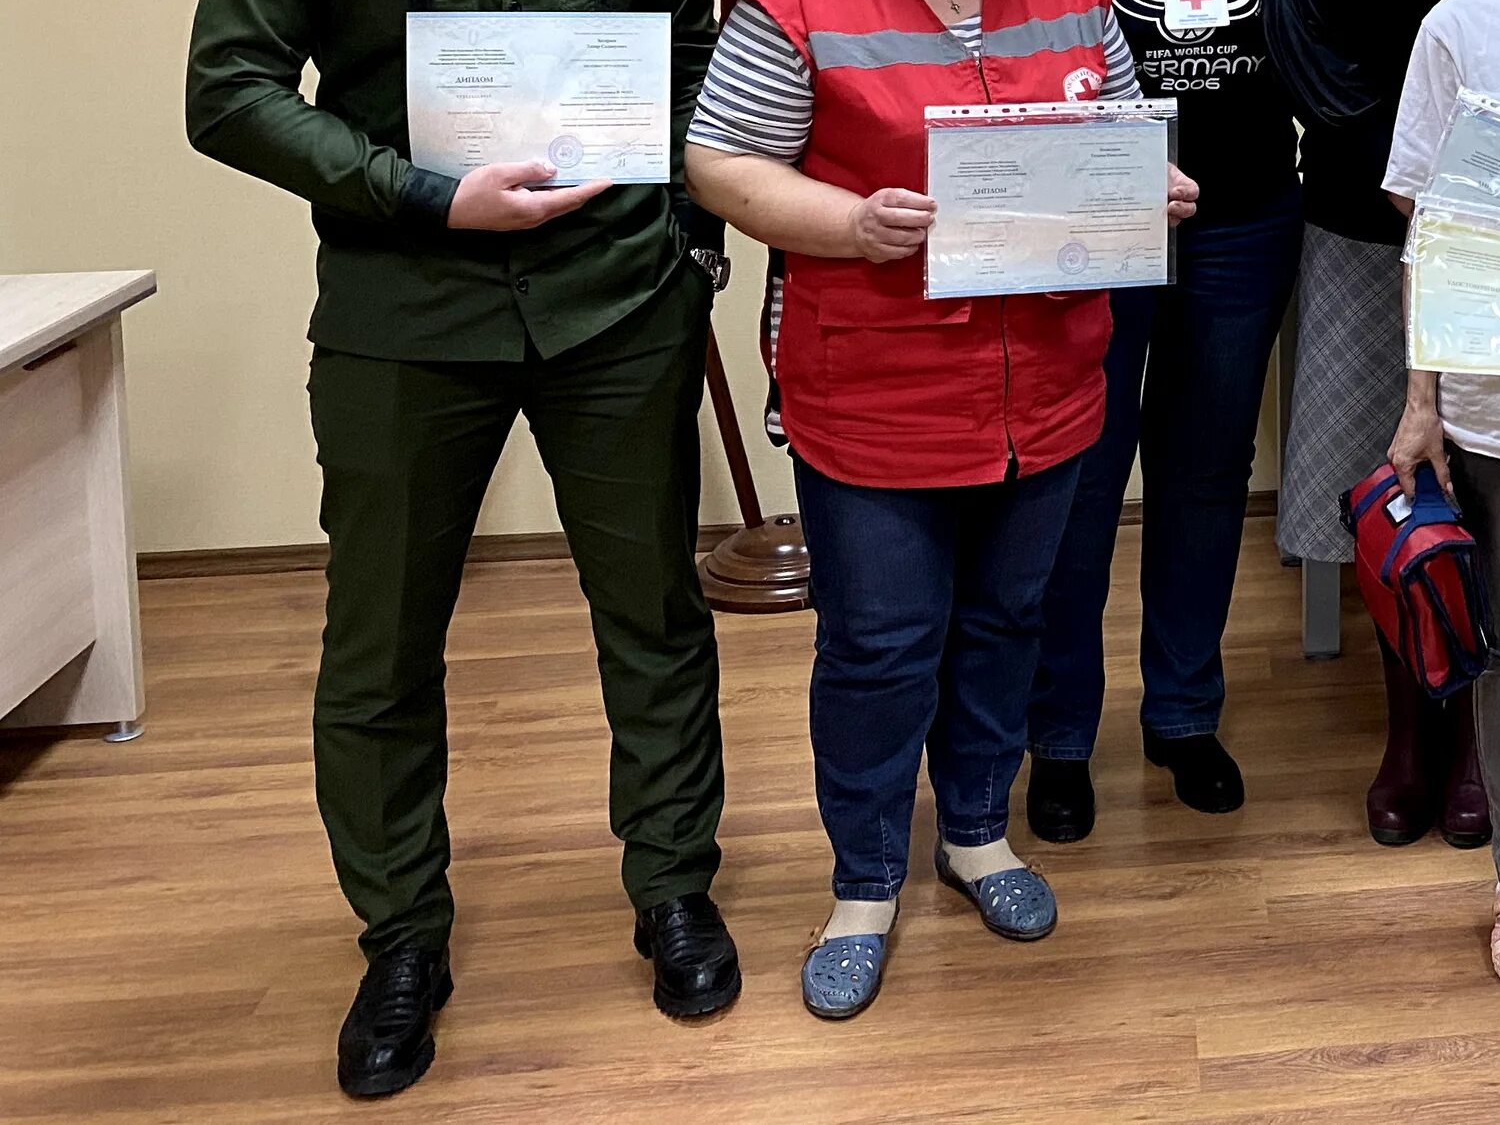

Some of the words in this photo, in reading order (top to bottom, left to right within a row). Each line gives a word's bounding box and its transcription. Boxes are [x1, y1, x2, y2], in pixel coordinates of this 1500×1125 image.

[1145, 49, 1173, 59] FIFA
[1174, 45, 1214, 57] WORLD
[1216, 44, 1239, 54] CUP
[1160, 77, 1220, 91] 2006
